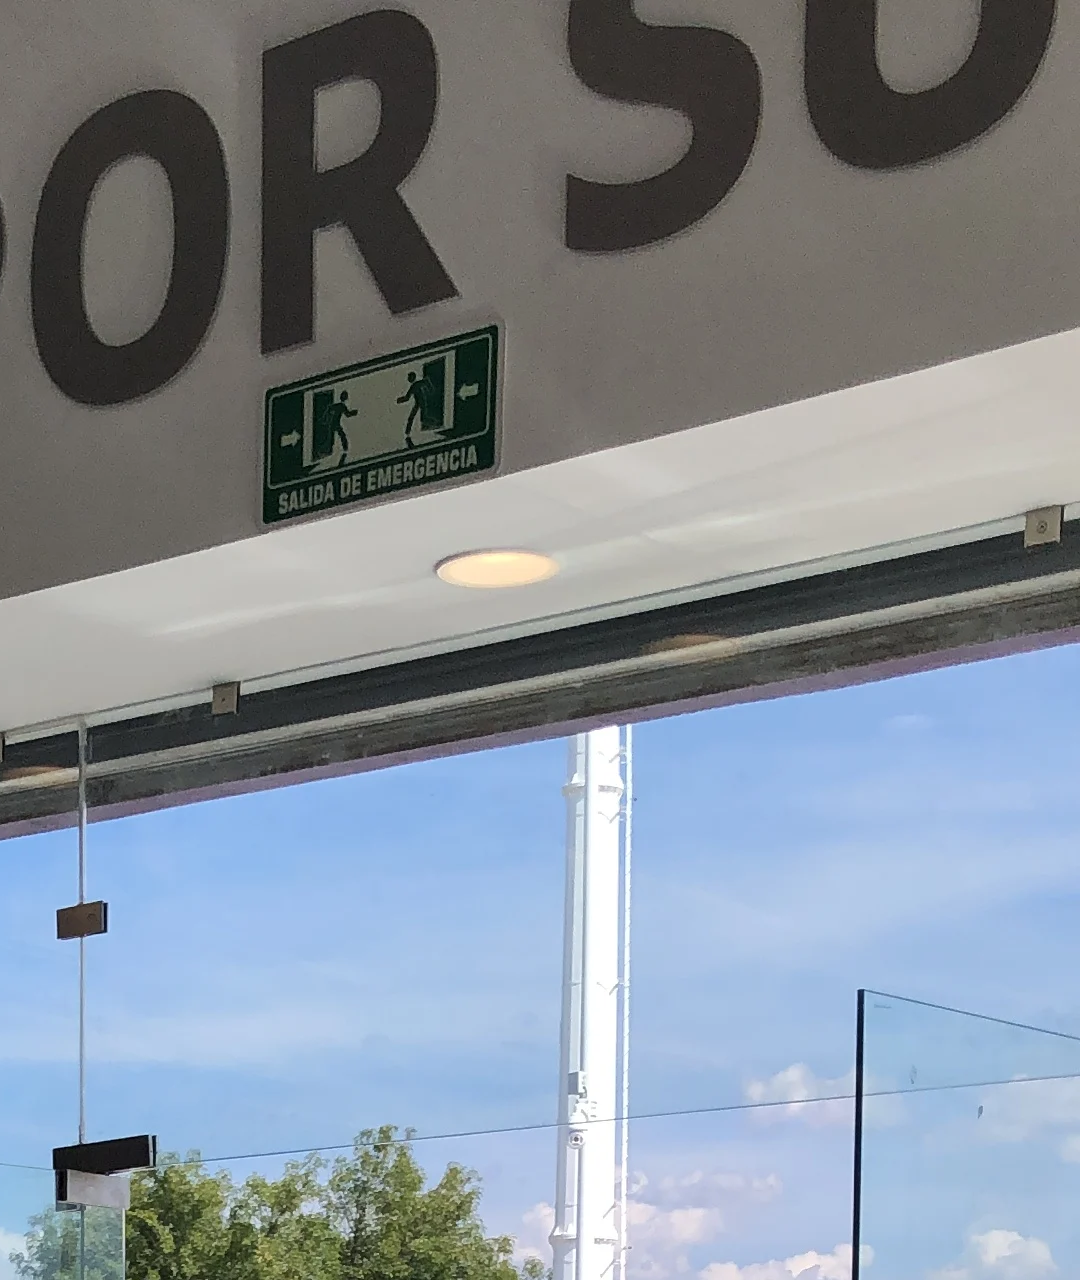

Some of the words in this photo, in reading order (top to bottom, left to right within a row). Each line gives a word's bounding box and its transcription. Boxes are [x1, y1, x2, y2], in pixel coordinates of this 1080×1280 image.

[278, 480, 335, 514] SALIDA
[340, 474, 361, 498] DE
[367, 444, 478, 492] EMERGENCIA
